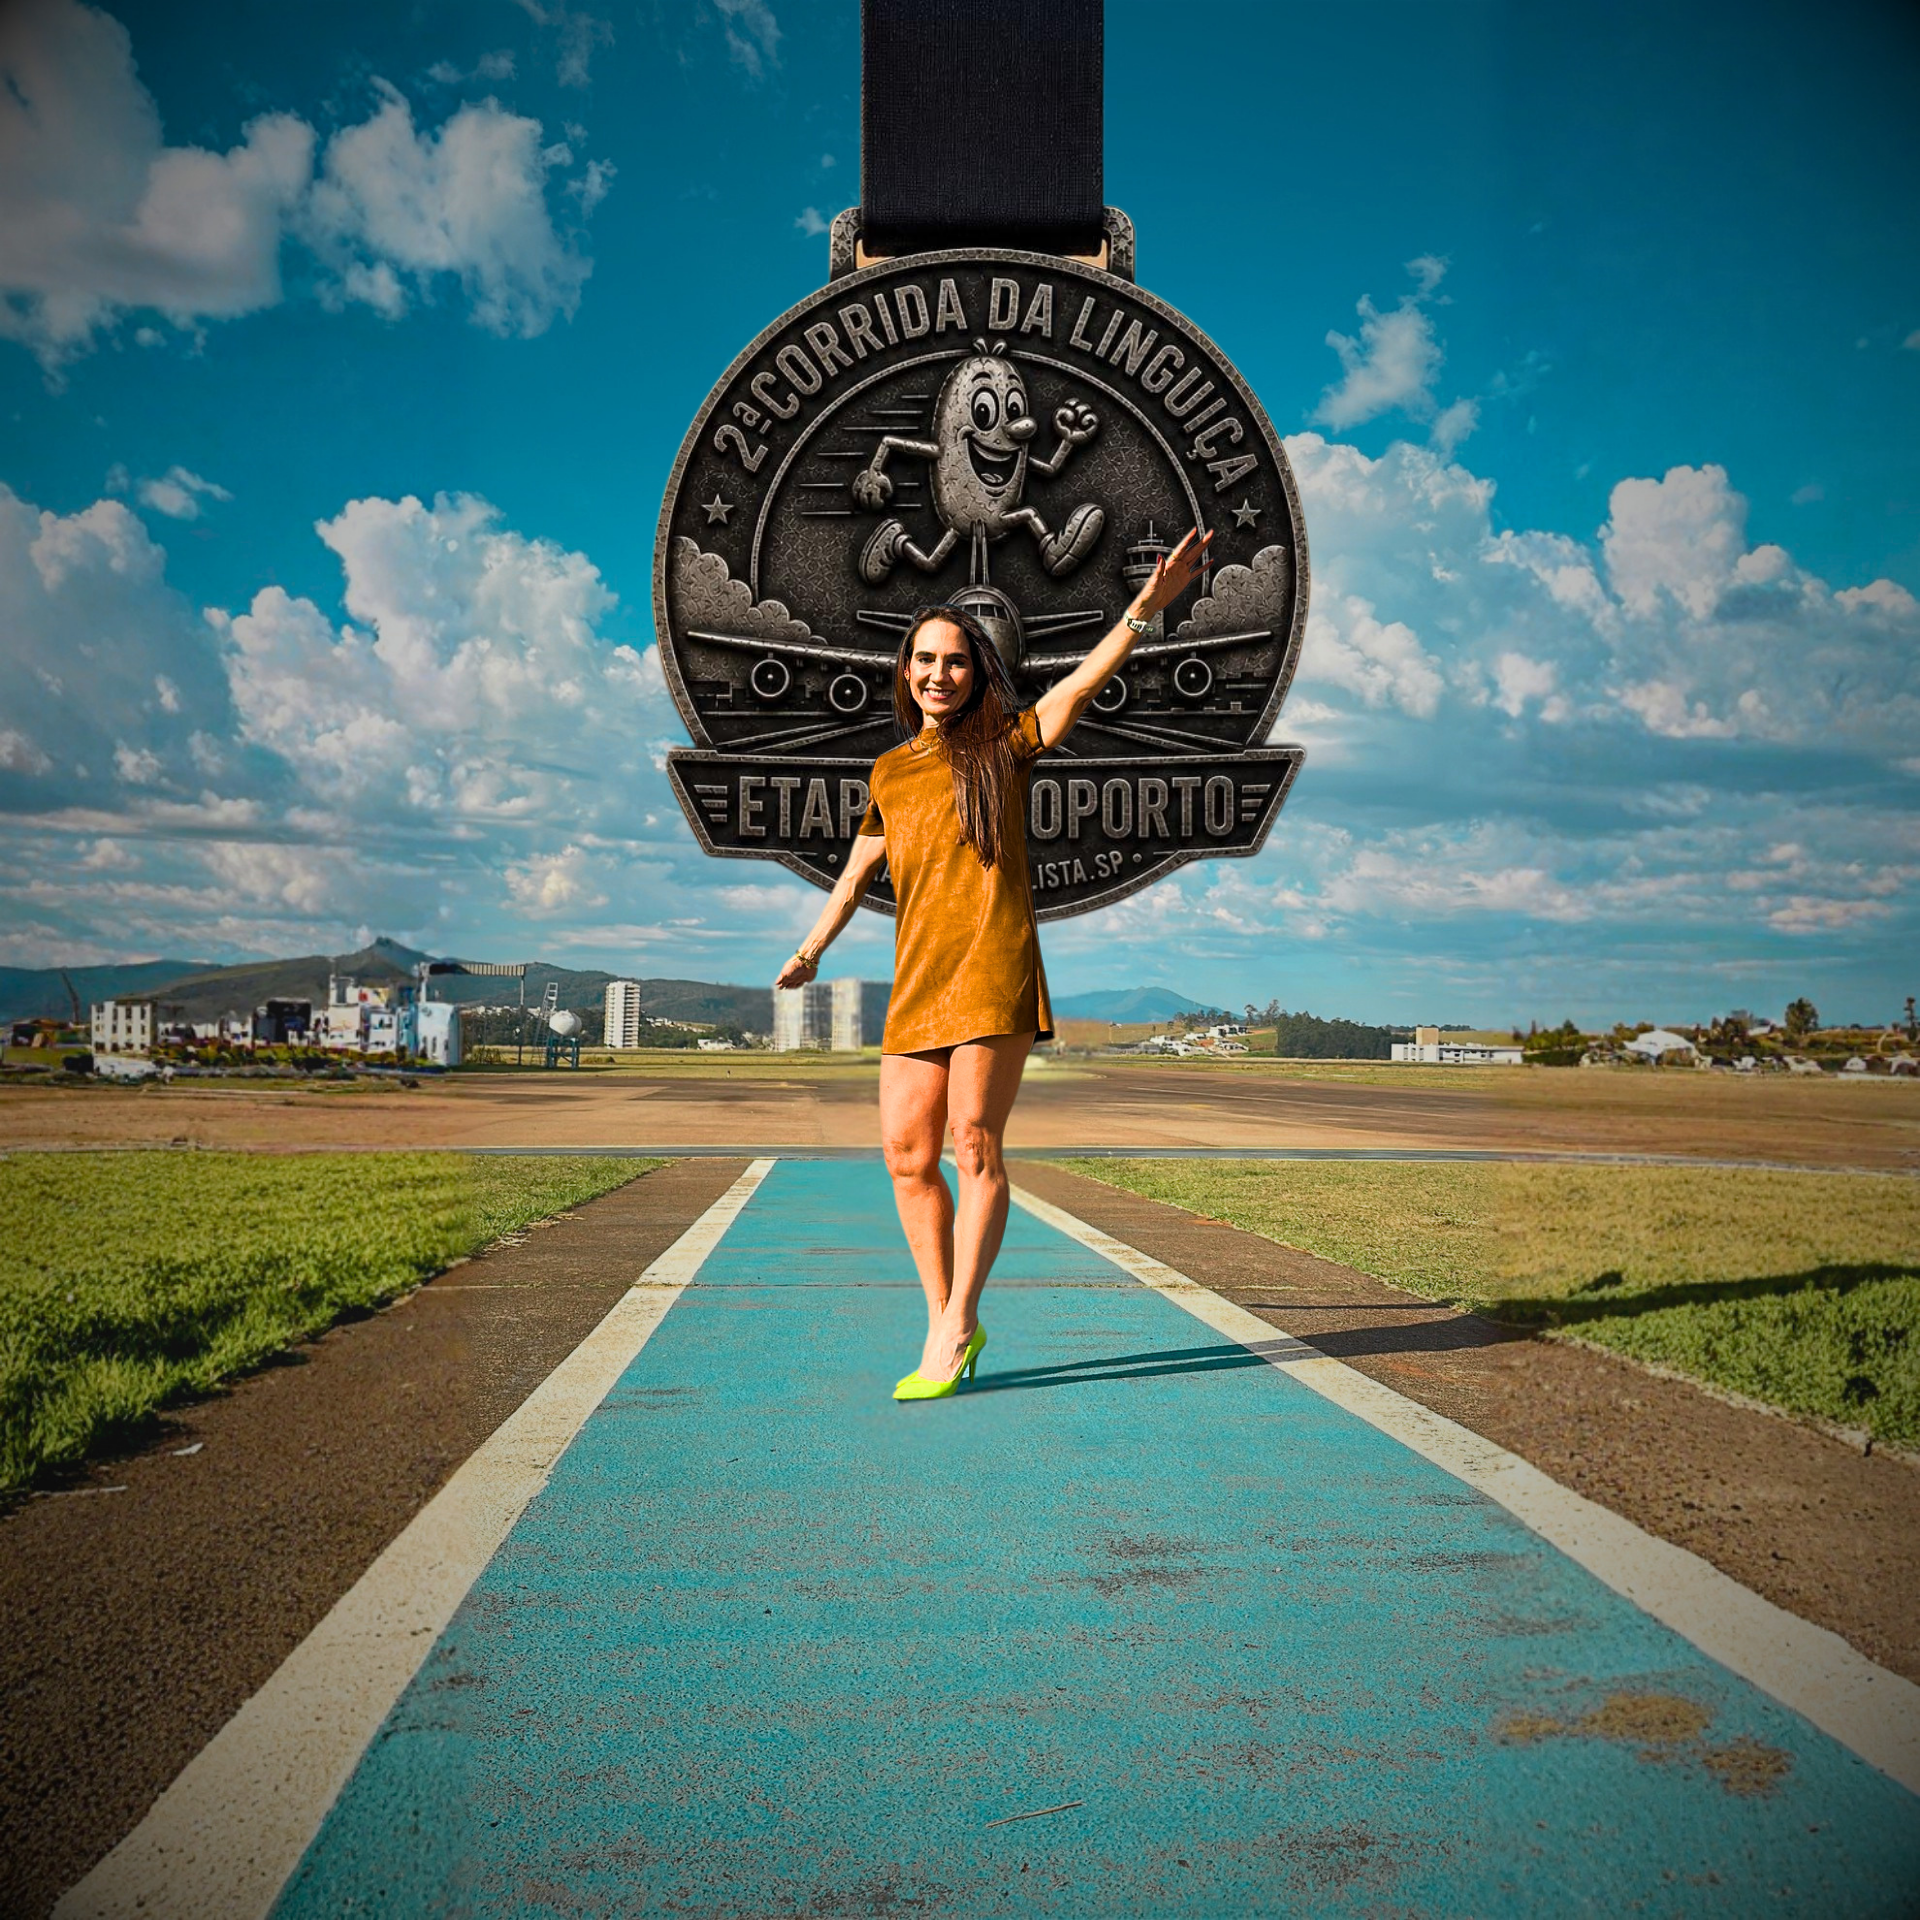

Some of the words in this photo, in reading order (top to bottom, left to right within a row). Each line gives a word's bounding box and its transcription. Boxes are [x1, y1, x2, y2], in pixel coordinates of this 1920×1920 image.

[751, 278, 968, 419] CORRIDA
[988, 277, 1053, 338] DA
[1069, 296, 1259, 492] LINGUIÇA
[739, 775, 870, 838] ETAP
[1031, 775, 1235, 840] OPORTO
